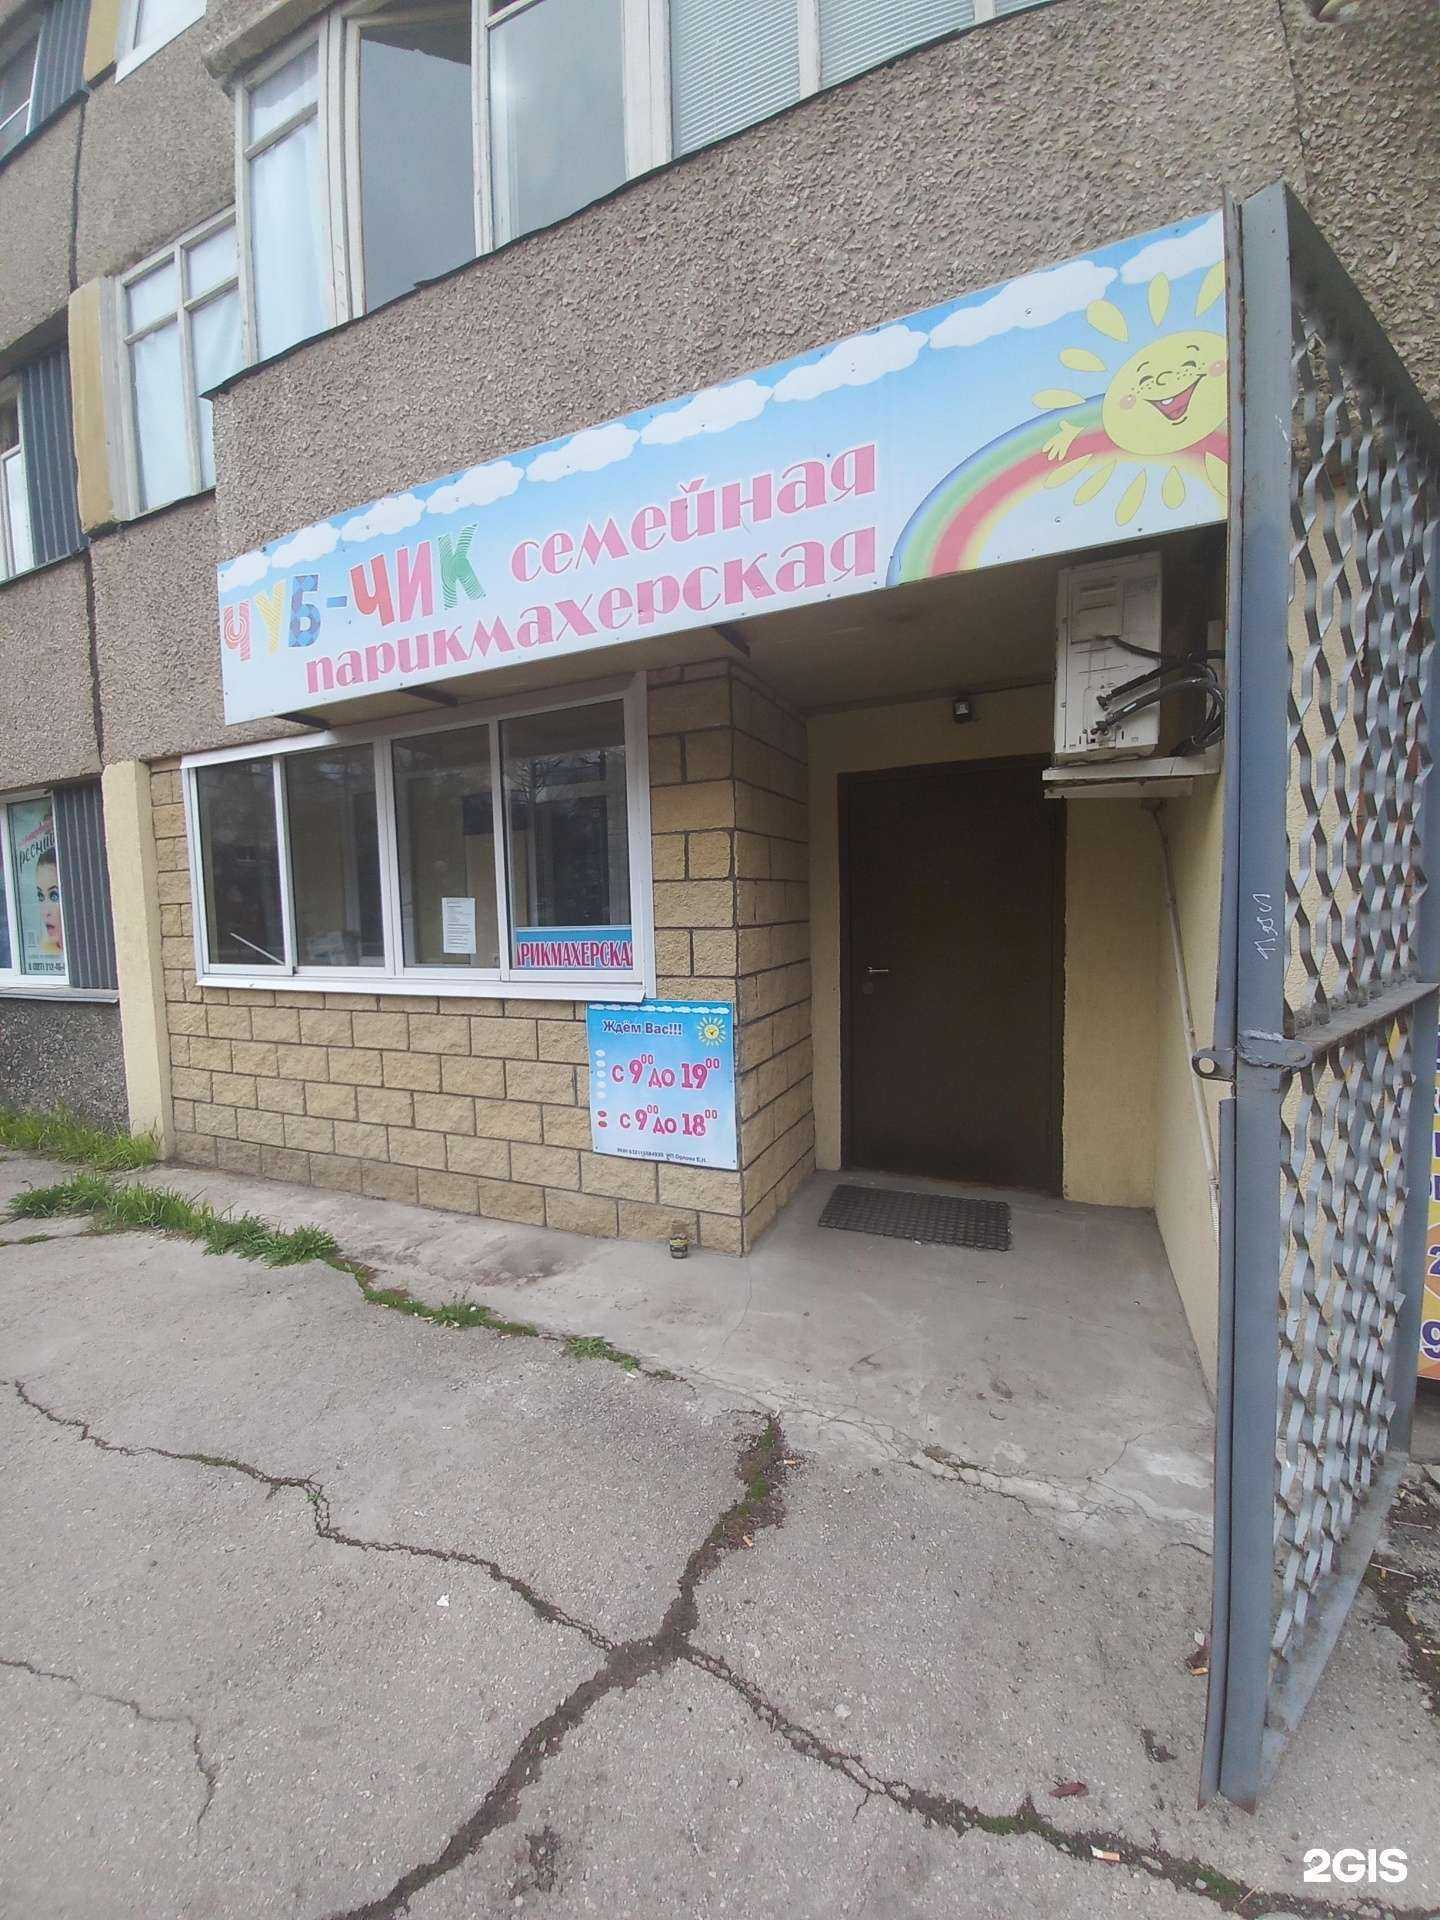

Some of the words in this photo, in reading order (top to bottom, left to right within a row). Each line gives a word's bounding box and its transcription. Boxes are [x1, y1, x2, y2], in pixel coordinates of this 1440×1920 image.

[222, 523, 487, 661] ЧУБ-ЧИК
[510, 443, 877, 584] семейная
[304, 525, 878, 695] парикмахерская
[602, 1020, 641, 1034] Ждём
[645, 1022, 682, 1036] Вас!!!
